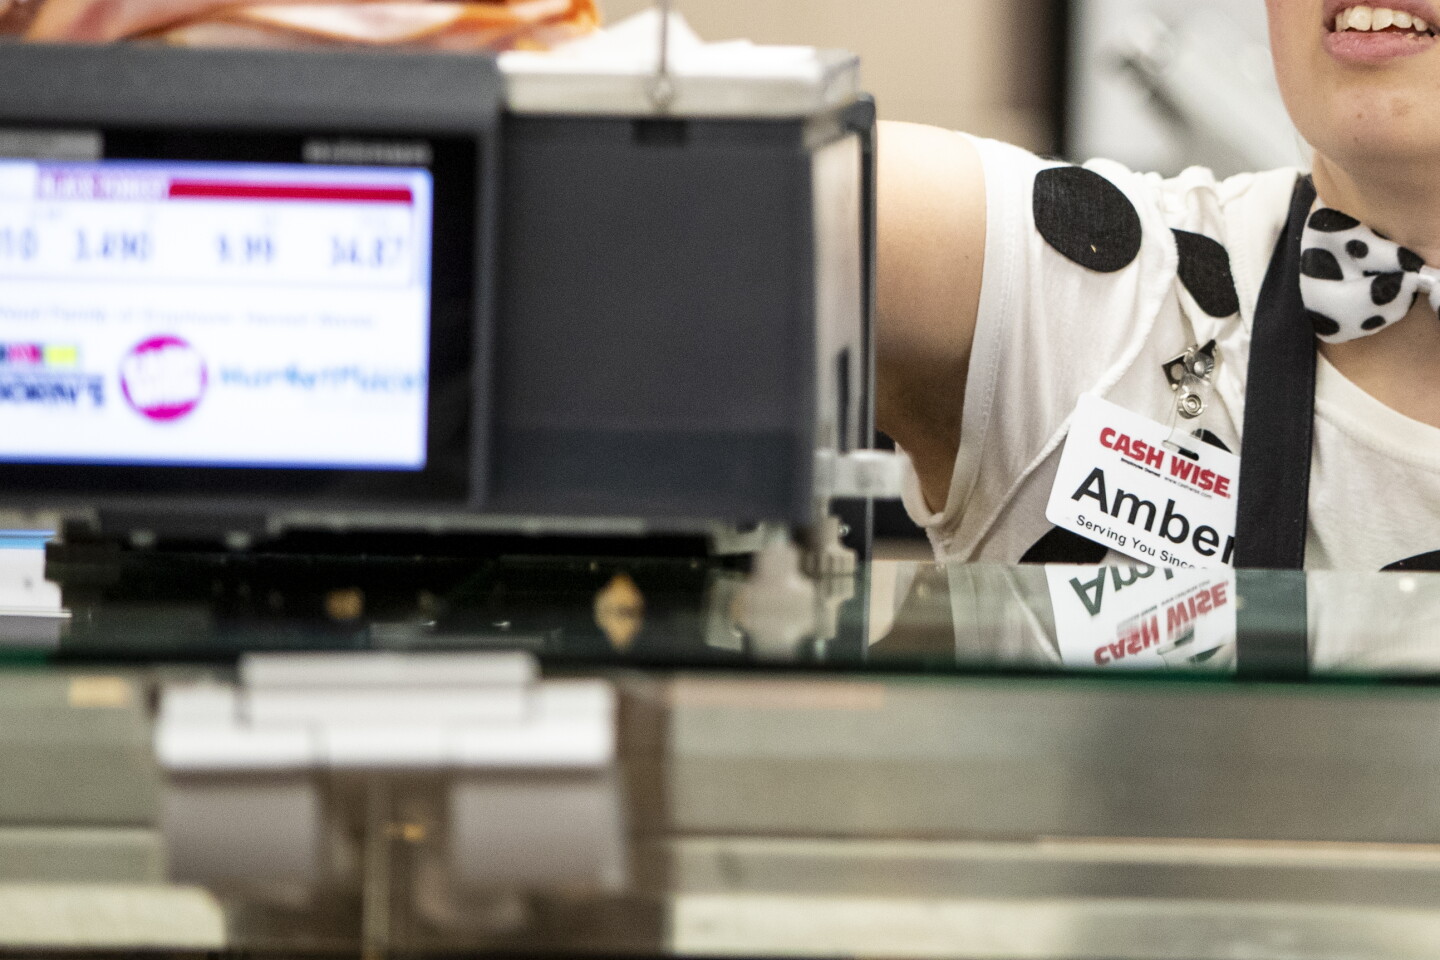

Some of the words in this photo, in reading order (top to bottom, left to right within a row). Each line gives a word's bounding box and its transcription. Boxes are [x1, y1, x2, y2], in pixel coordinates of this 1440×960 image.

[1100, 427, 1165, 469] CASH
[1170, 456, 1231, 498] WISE
[1071, 467, 1235, 564] Amber
[1076, 514, 1126, 546] Serving
[1132, 537, 1156, 557] You
